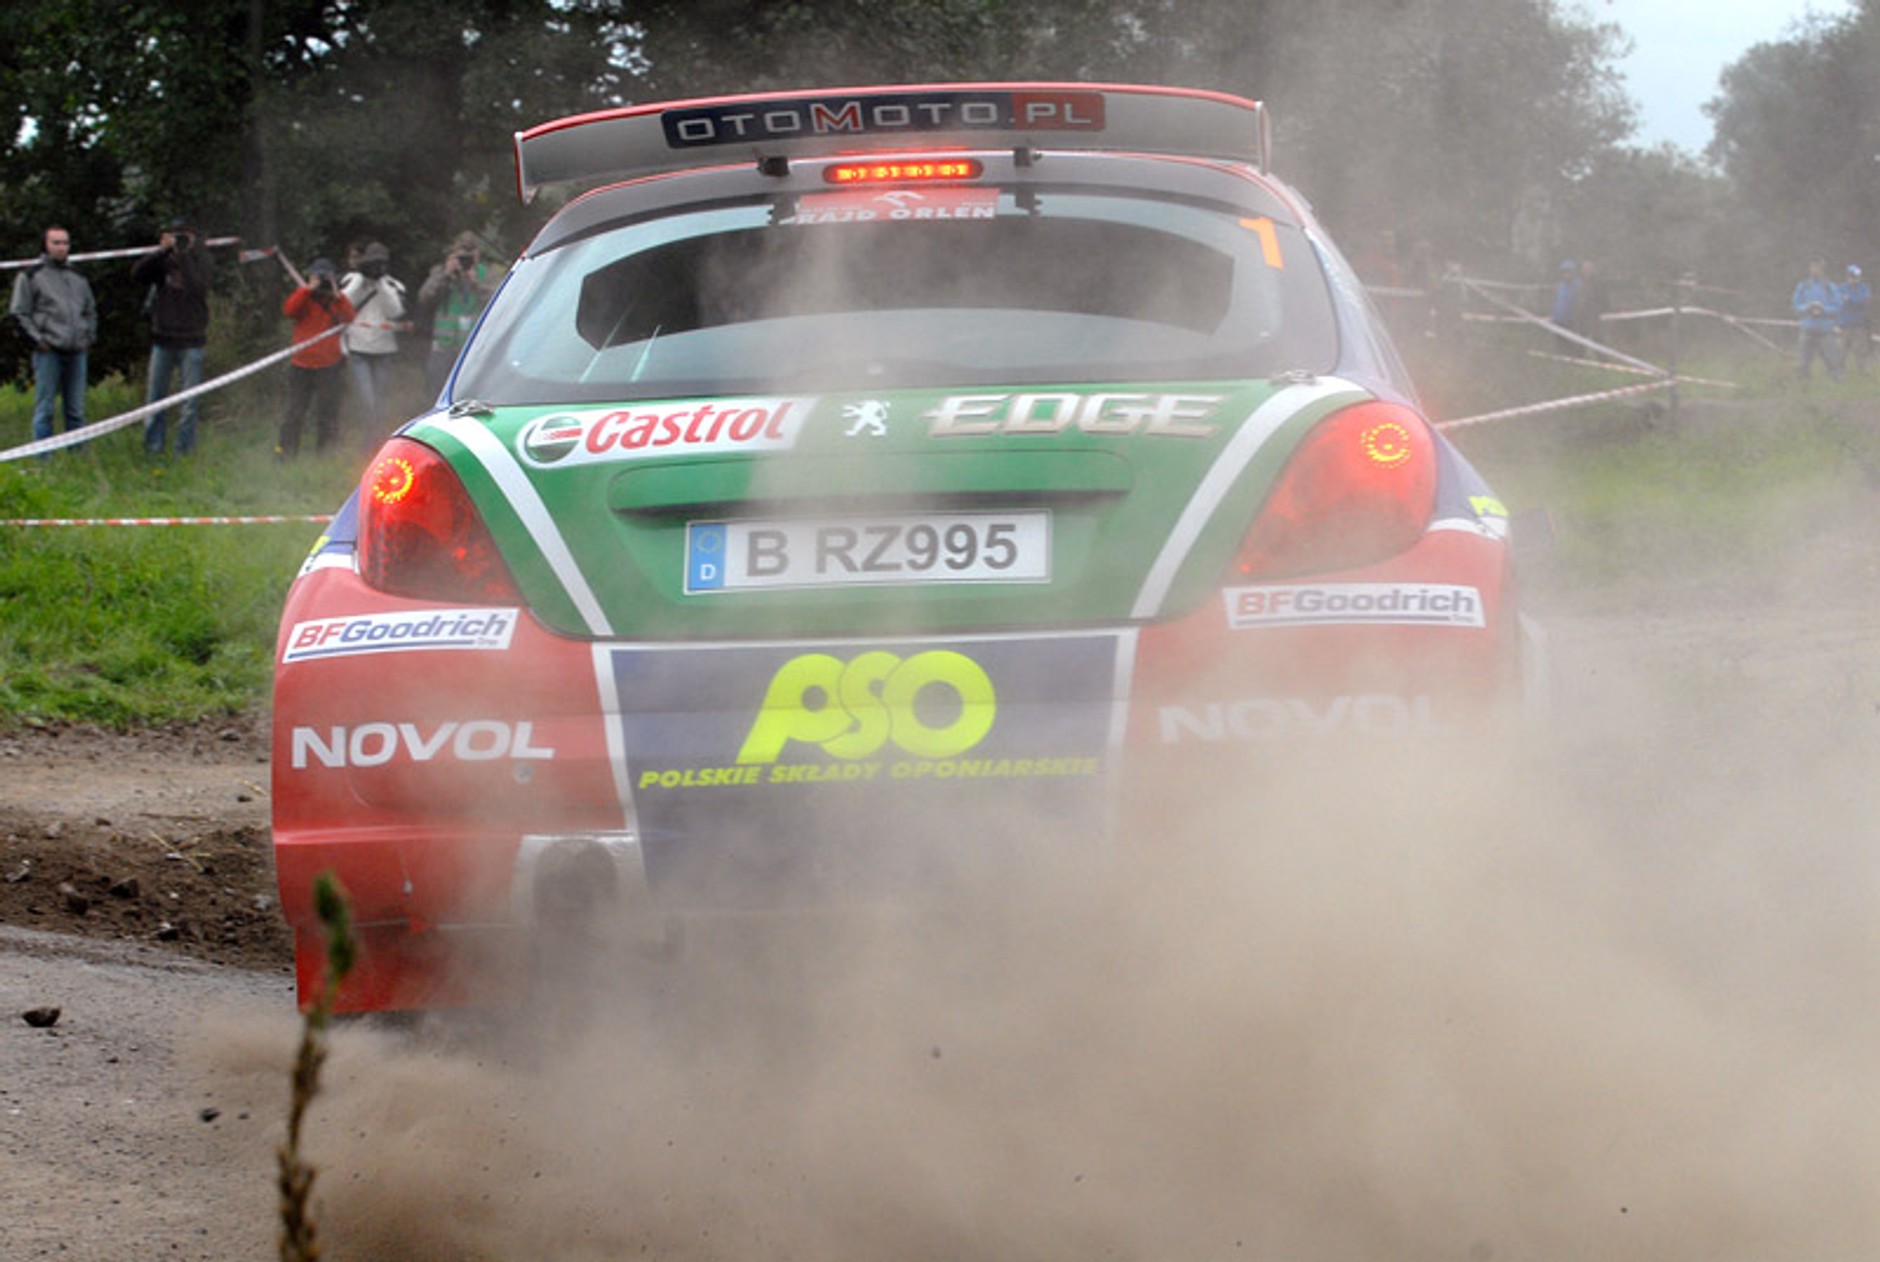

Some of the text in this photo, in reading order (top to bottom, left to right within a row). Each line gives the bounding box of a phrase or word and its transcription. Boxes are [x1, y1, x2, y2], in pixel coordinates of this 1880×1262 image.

[796, 208, 877, 224] RAJD
[889, 206, 995, 220] ORLEN
[1239, 215, 1284, 271] 1
[585, 402, 793, 454] Castrol
[921, 393, 1224, 437] EDGE
[700, 564, 716, 580] D
[747, 523, 1018, 577] B RZ995
[1236, 589, 1475, 616] BFGoodrich
[293, 614, 508, 649] BFGoodrich
[735, 650, 997, 764] PSO
[1158, 696, 1453, 744] NOVOL
[291, 720, 556, 769] NOVOL
[639, 757, 1100, 789] POLSKIE SKŁADY OPONIARSKIE
